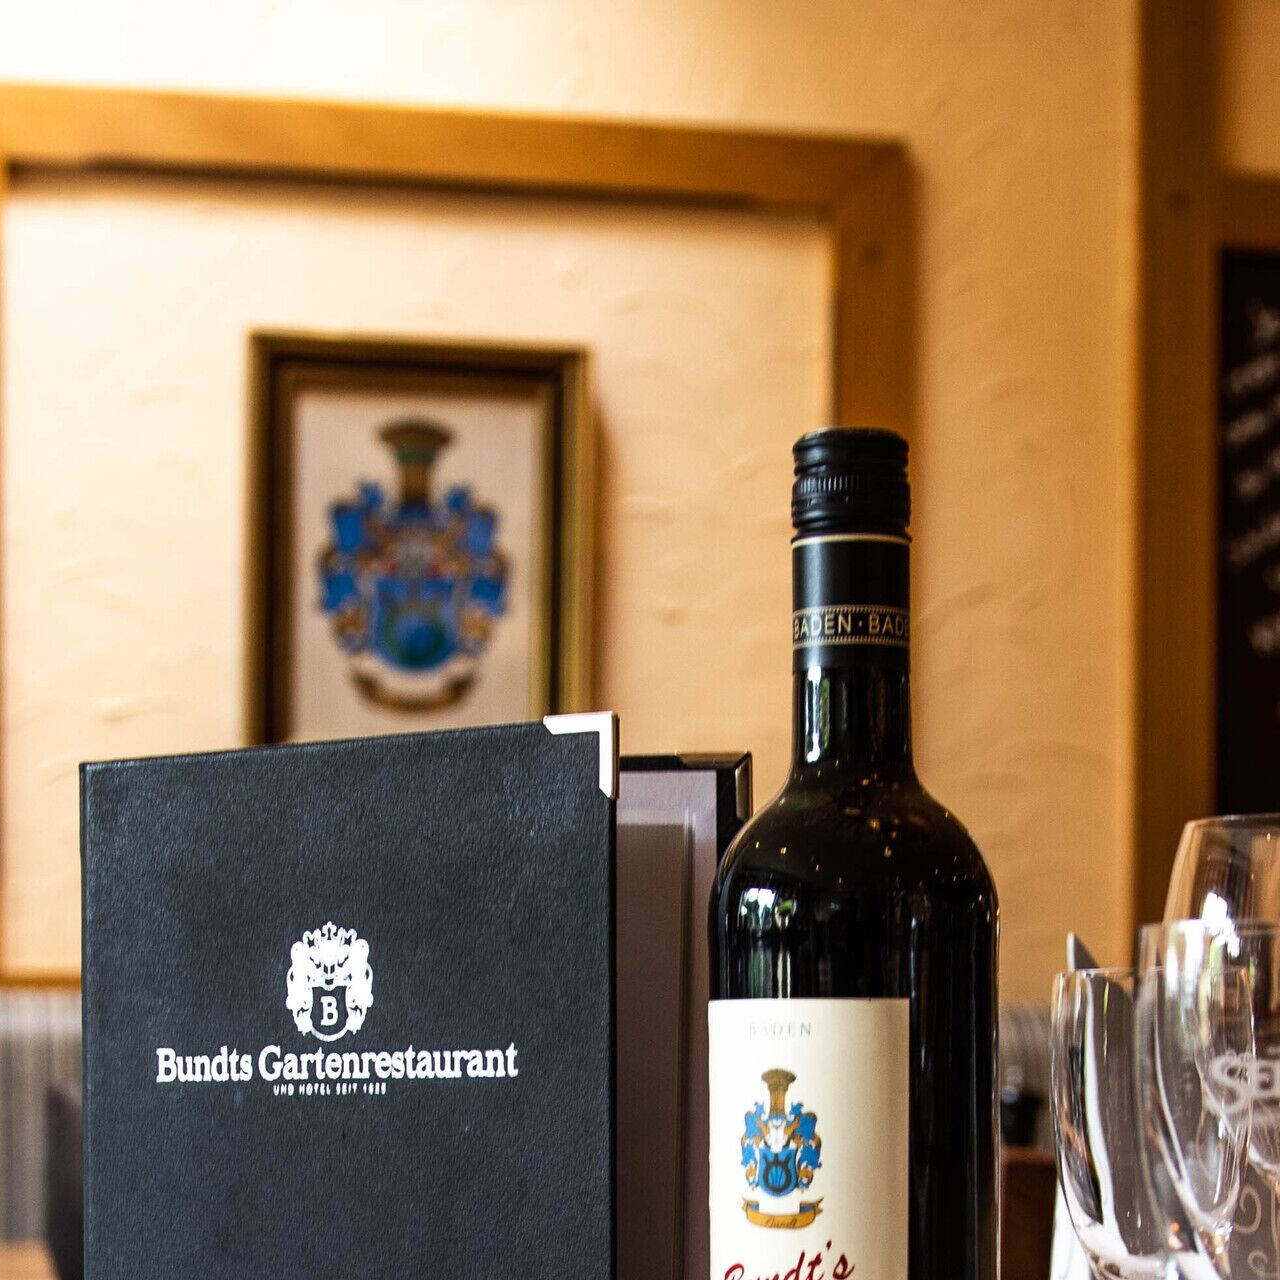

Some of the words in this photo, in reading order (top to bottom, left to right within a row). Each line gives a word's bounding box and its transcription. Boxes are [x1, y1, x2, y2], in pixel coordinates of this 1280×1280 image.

[794, 613, 851, 639] BADEN
[320, 996, 339, 1026] B
[156, 1046, 253, 1083] Bundts
[258, 1041, 519, 1081] Gartenrestaurant
[273, 1083, 295, 1096] UND
[299, 1082, 331, 1096] HOTEL
